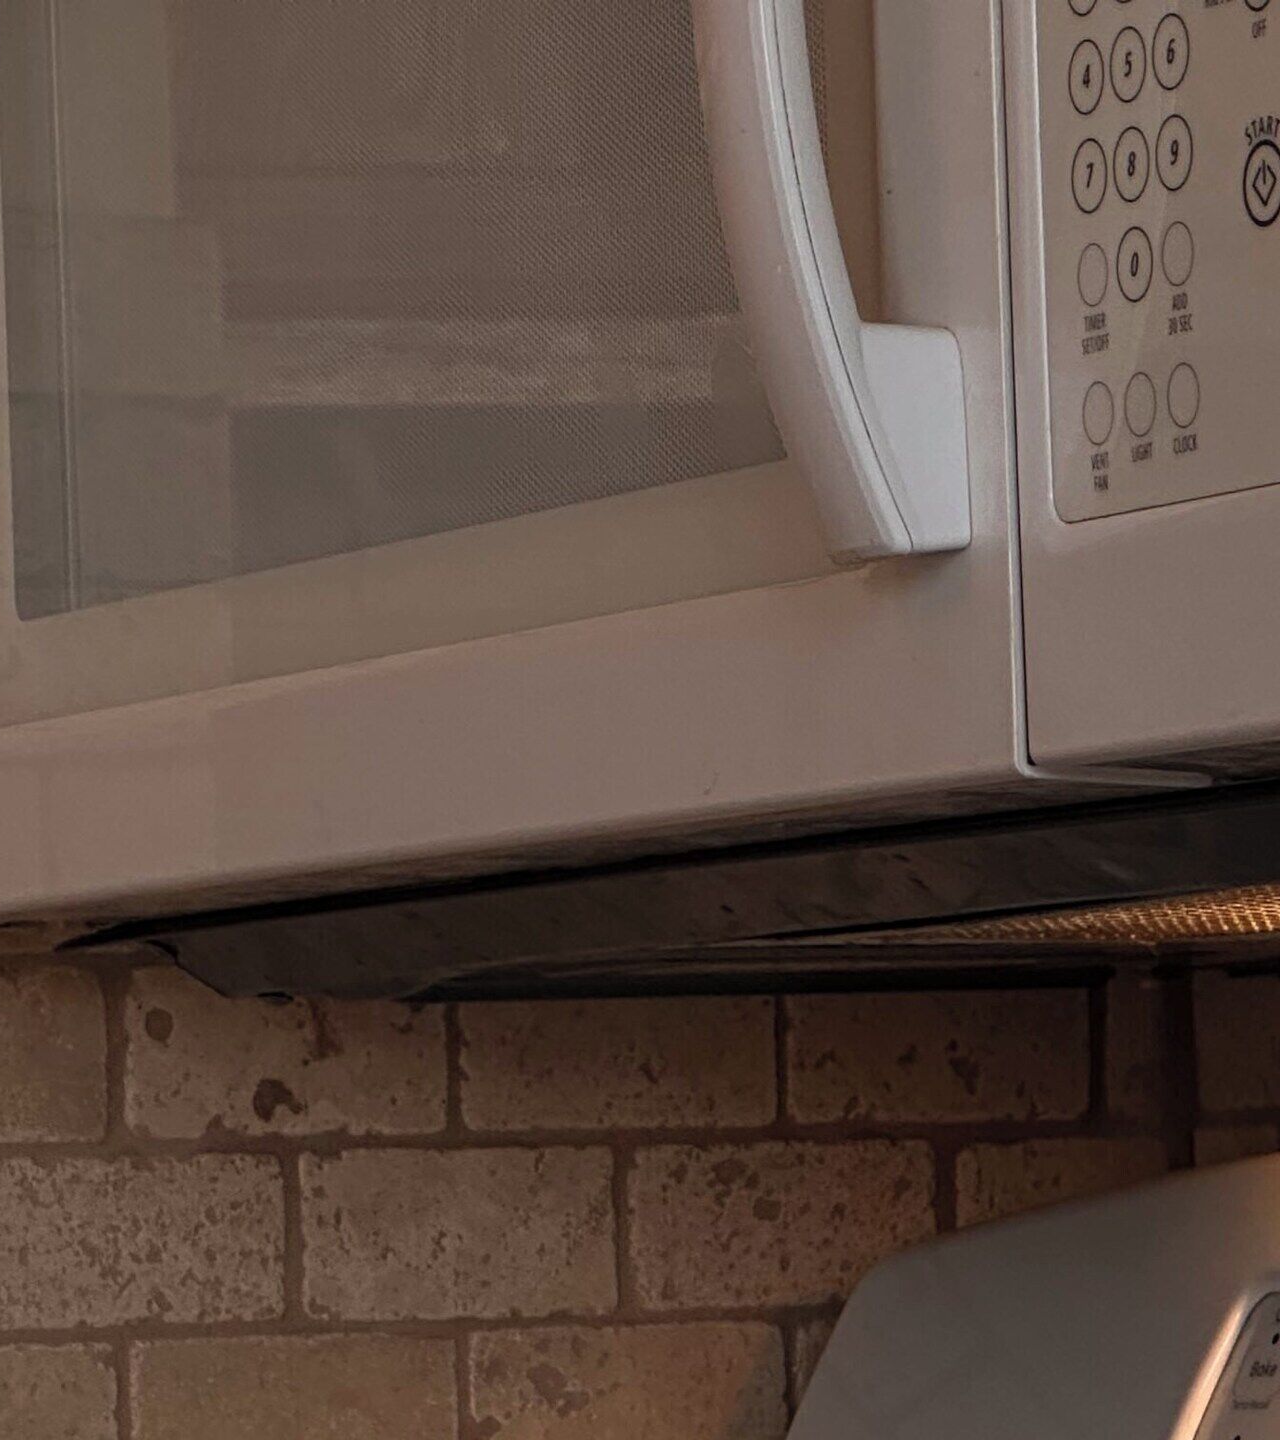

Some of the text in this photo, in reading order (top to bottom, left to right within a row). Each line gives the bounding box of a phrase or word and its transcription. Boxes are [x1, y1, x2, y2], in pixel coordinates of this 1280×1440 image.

[1082, 38, 1175, 88] 4 5 6
[1245, 115, 1280, 146] START
[1086, 139, 1179, 189] 7 8 9
[1131, 252, 1139, 277] 0
[1173, 434, 1197, 455] CLOCK
[1250, 1361, 1278, 1377] Bake
